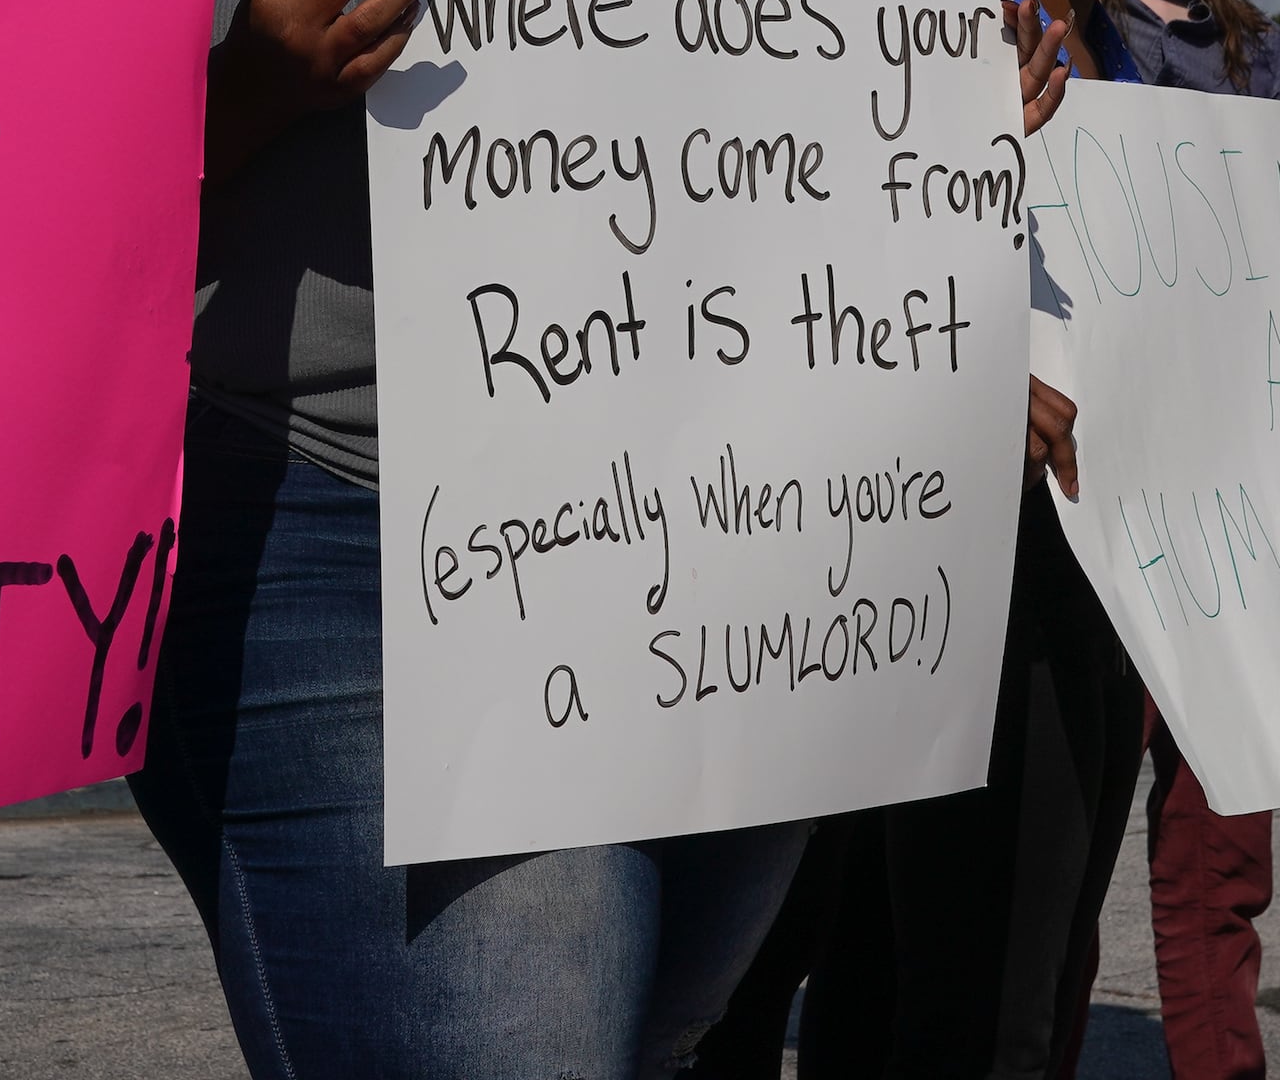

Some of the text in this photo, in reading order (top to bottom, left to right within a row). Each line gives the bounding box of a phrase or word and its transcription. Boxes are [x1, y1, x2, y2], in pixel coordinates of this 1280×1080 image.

[870, 0, 997, 142] your
[681, 128, 831, 204] come
[881, 133, 1026, 251] from?
[466, 264, 972, 404] Rent is theft
[421, 450, 670, 626] (especially
[827, 456, 953, 598] you're
[543, 565, 951, 729] a SLUMLORD!)
